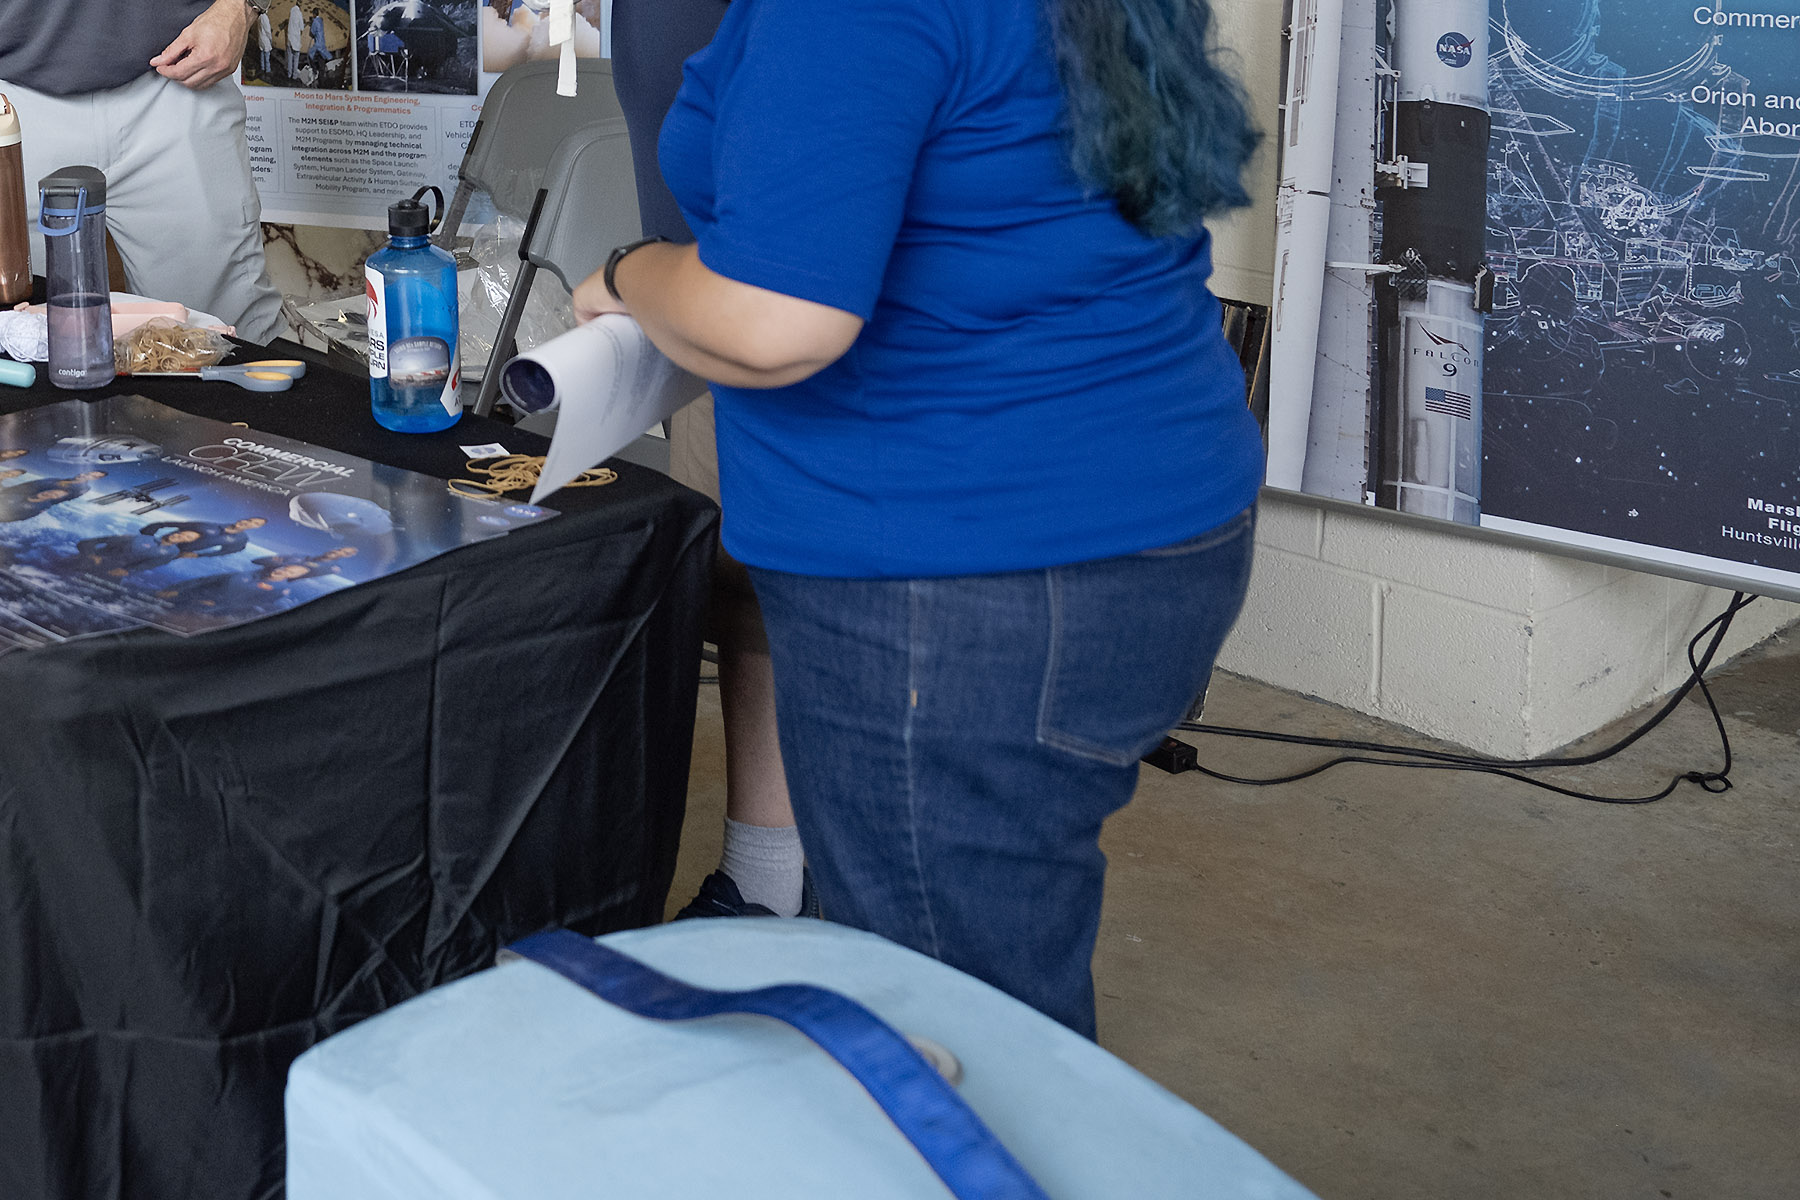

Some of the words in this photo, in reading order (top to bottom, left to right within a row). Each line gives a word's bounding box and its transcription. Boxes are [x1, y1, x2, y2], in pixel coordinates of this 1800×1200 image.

[1693, 6, 1800, 30] Commer
[1439, 43, 1471, 55] NASA
[294, 91, 315, 99] Moon
[315, 92, 323, 100] to
[324, 93, 343, 101] Mars
[344, 94, 372, 103] System
[1691, 85, 1756, 107] Orion
[305, 103, 345, 112] Integration
[353, 105, 411, 115] Programmatics
[288, 116, 300, 124] The
[301, 117, 317, 125] M2M
[357, 120, 378, 128] within
[379, 121, 398, 129] ETDO
[399, 122, 428, 131] provides
[295, 135, 311, 143] M2M
[312, 136, 343, 146] Programs
[345, 138, 353, 146] by
[354, 139, 388, 149] managing
[389, 141, 422, 150] technical
[291, 145, 327, 154] integration
[352, 148, 369, 156] M2M
[370, 149, 384, 157] and
[397, 152, 427, 160] program
[1413, 347, 1479, 367] FALCON
[58, 368, 86, 378] contigo
[1442, 363, 1458, 377] 9
[189, 444, 343, 487] CREW
[223, 437, 356, 478] COMMERCIAL
[161, 456, 223, 478] LAUNCH
[221, 473, 291, 496] AMERICA
[1747, 497, 1800, 518] Mars
[1722, 525, 1800, 550] Huntsvill
